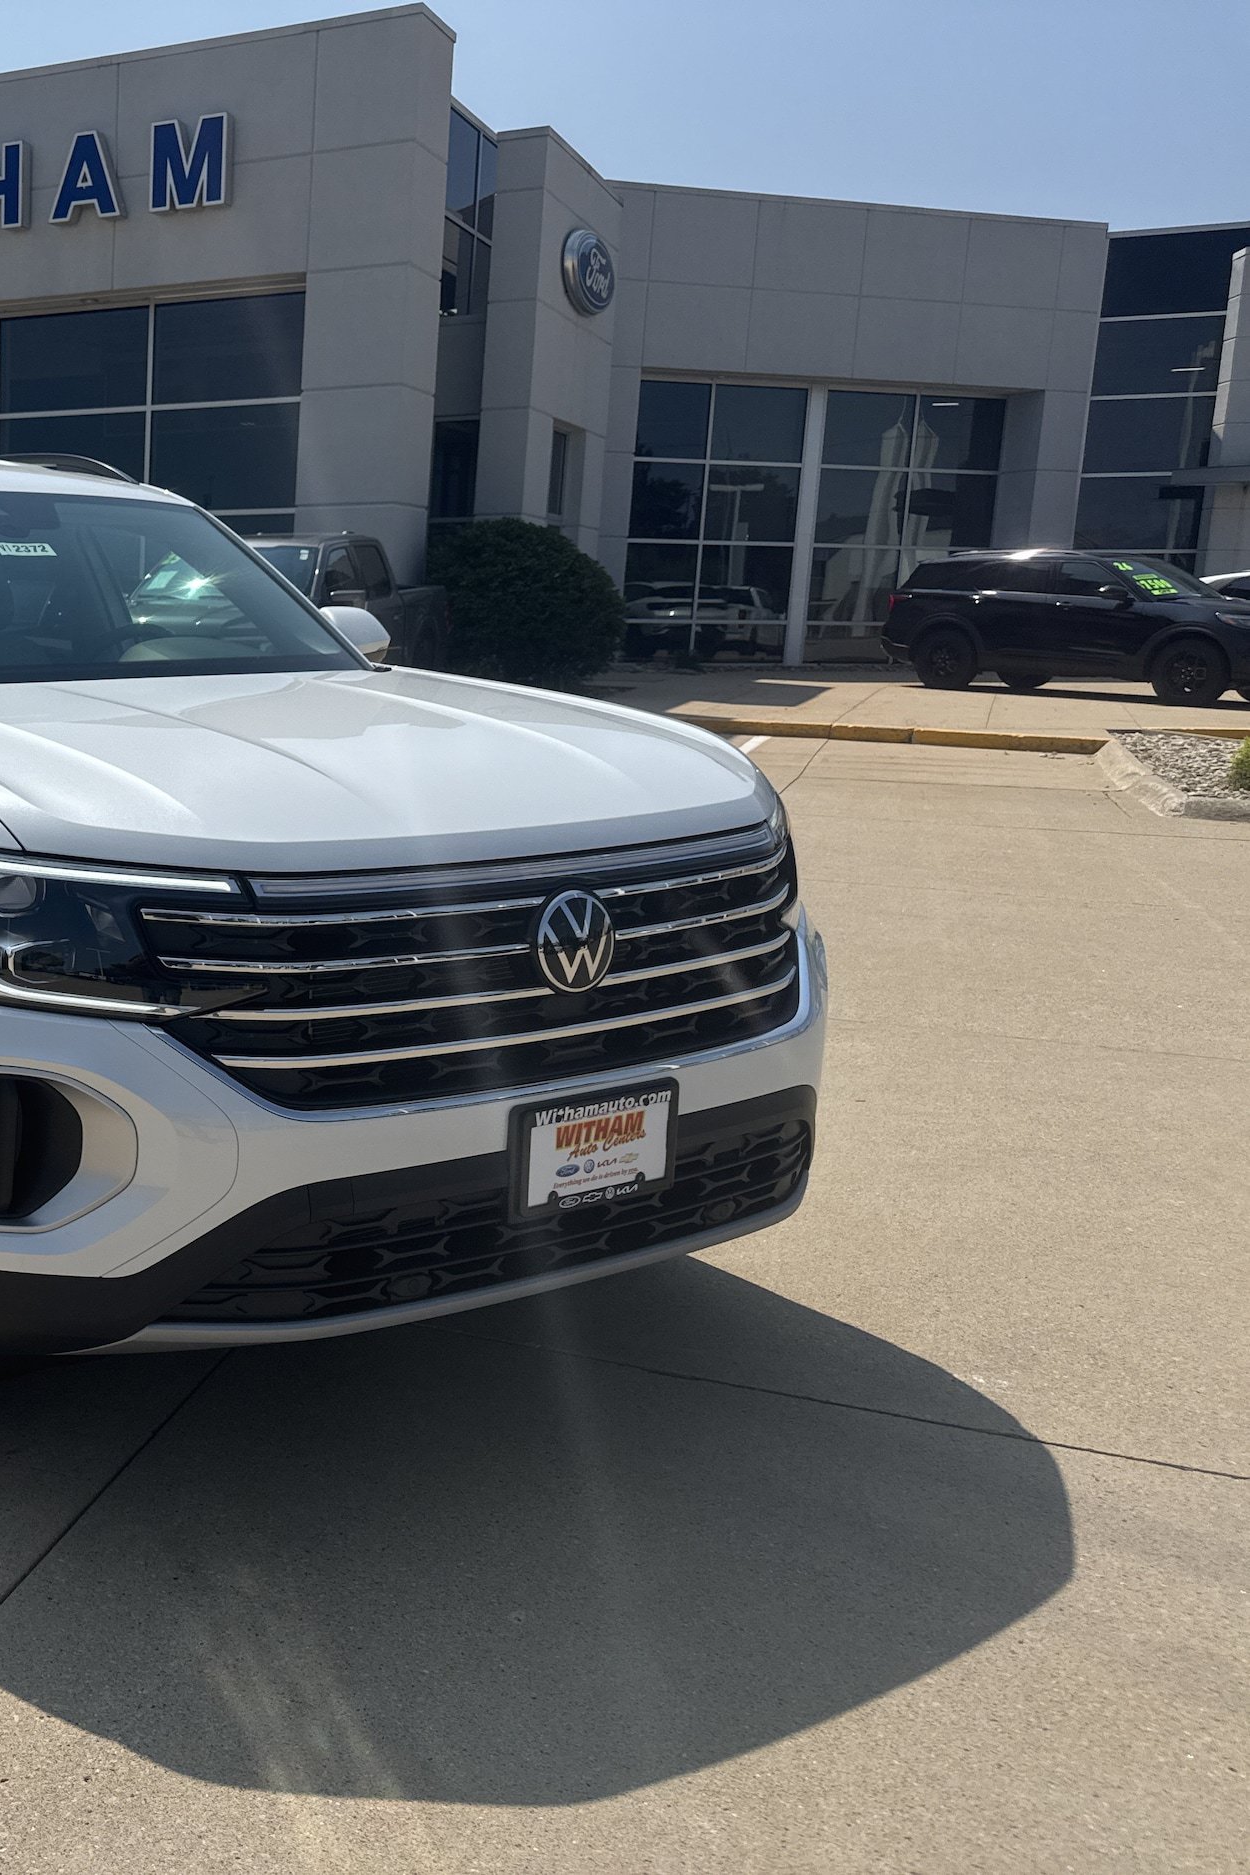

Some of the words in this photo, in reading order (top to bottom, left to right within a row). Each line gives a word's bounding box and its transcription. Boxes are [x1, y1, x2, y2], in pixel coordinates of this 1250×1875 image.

[585, 248, 611, 299] Ford
[535, 1090, 672, 1127] Withamauto.com
[556, 1110, 645, 1150] WITHAM
[568, 1144, 598, 1161] Auto
[602, 1129, 646, 1151] Centers
